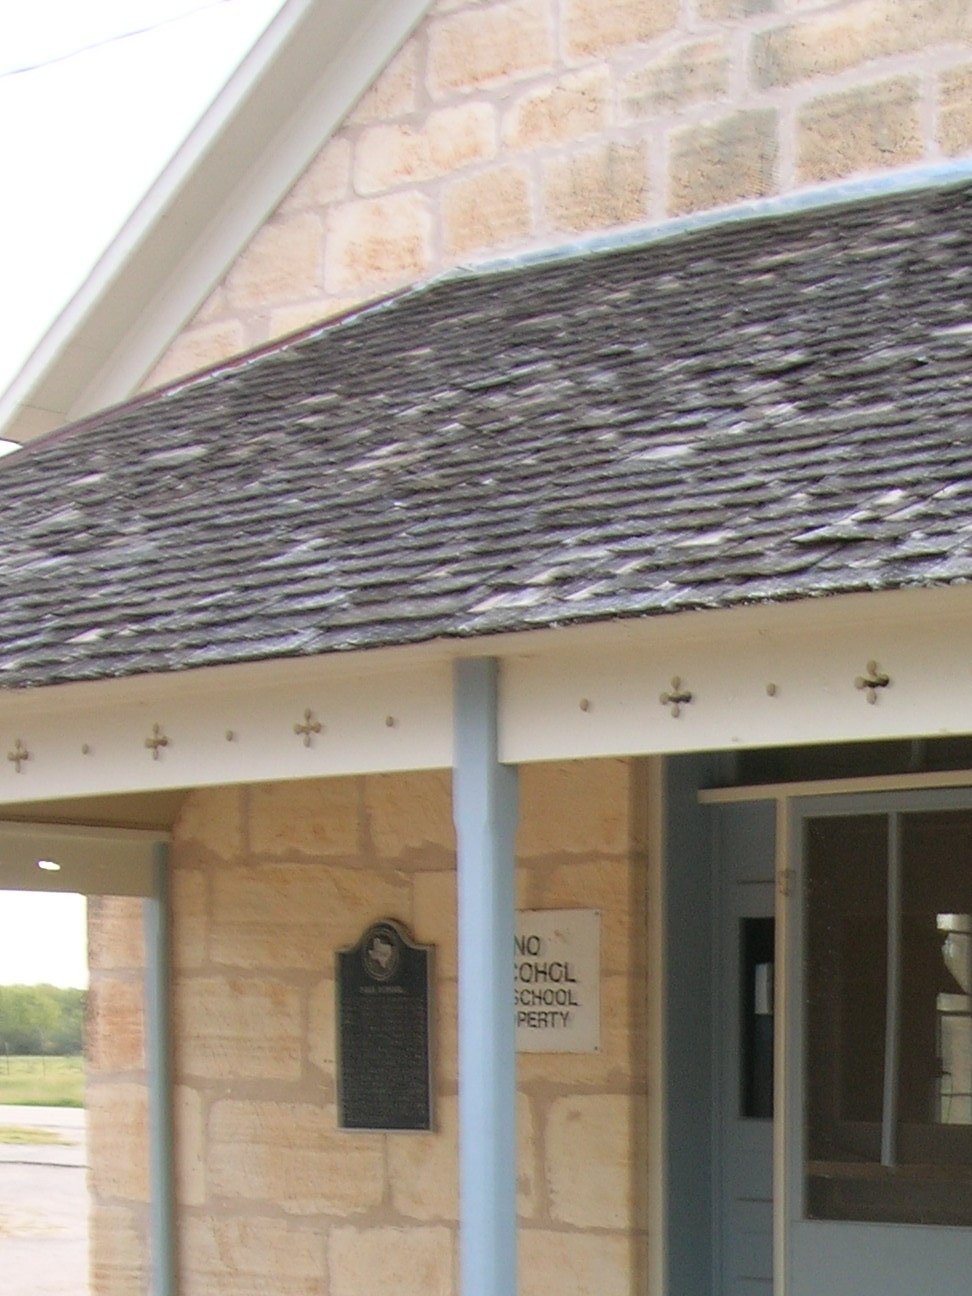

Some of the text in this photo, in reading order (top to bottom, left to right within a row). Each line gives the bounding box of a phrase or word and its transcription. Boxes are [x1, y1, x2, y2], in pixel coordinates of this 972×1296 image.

[515, 935, 542, 957] NO
[515, 963, 577, 984] OHOL
[516, 1010, 572, 1029] PERTY
